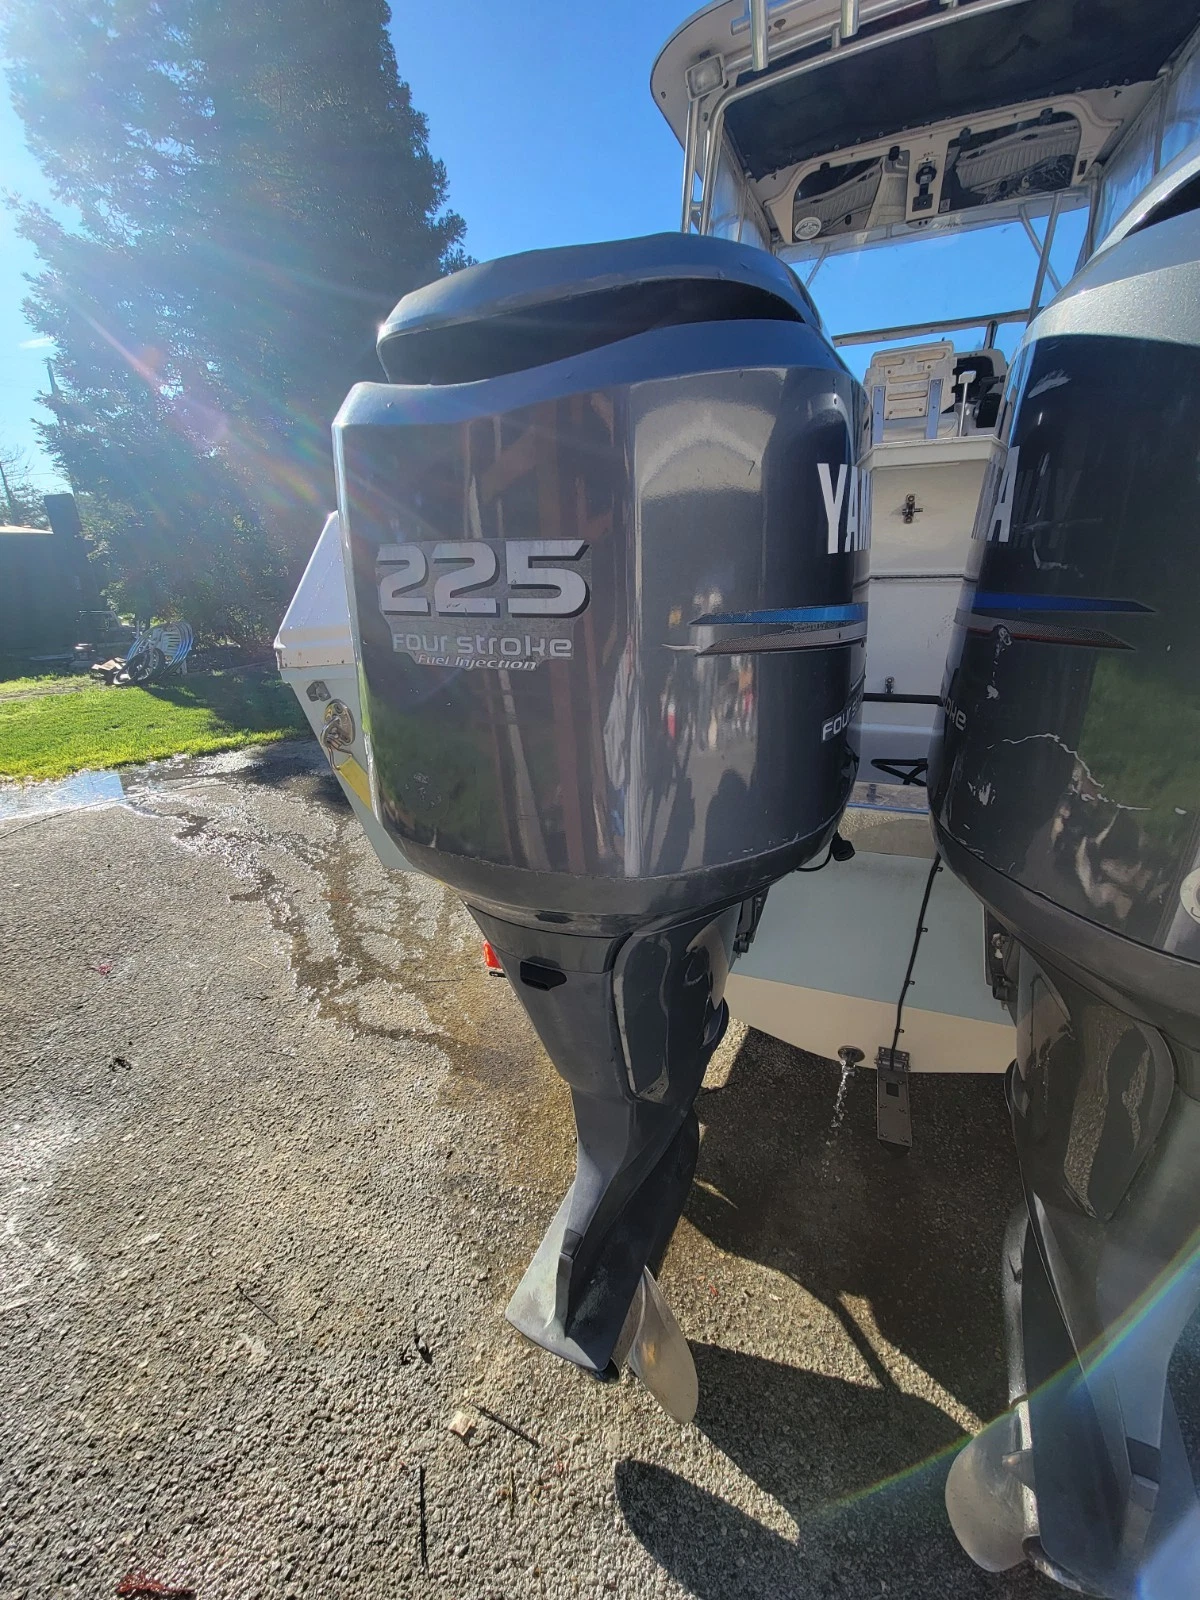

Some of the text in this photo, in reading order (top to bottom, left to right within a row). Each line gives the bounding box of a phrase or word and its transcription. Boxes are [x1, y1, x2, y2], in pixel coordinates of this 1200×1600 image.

[376, 540, 590, 618] 225
[418, 654, 537, 671] Fuel Injection
